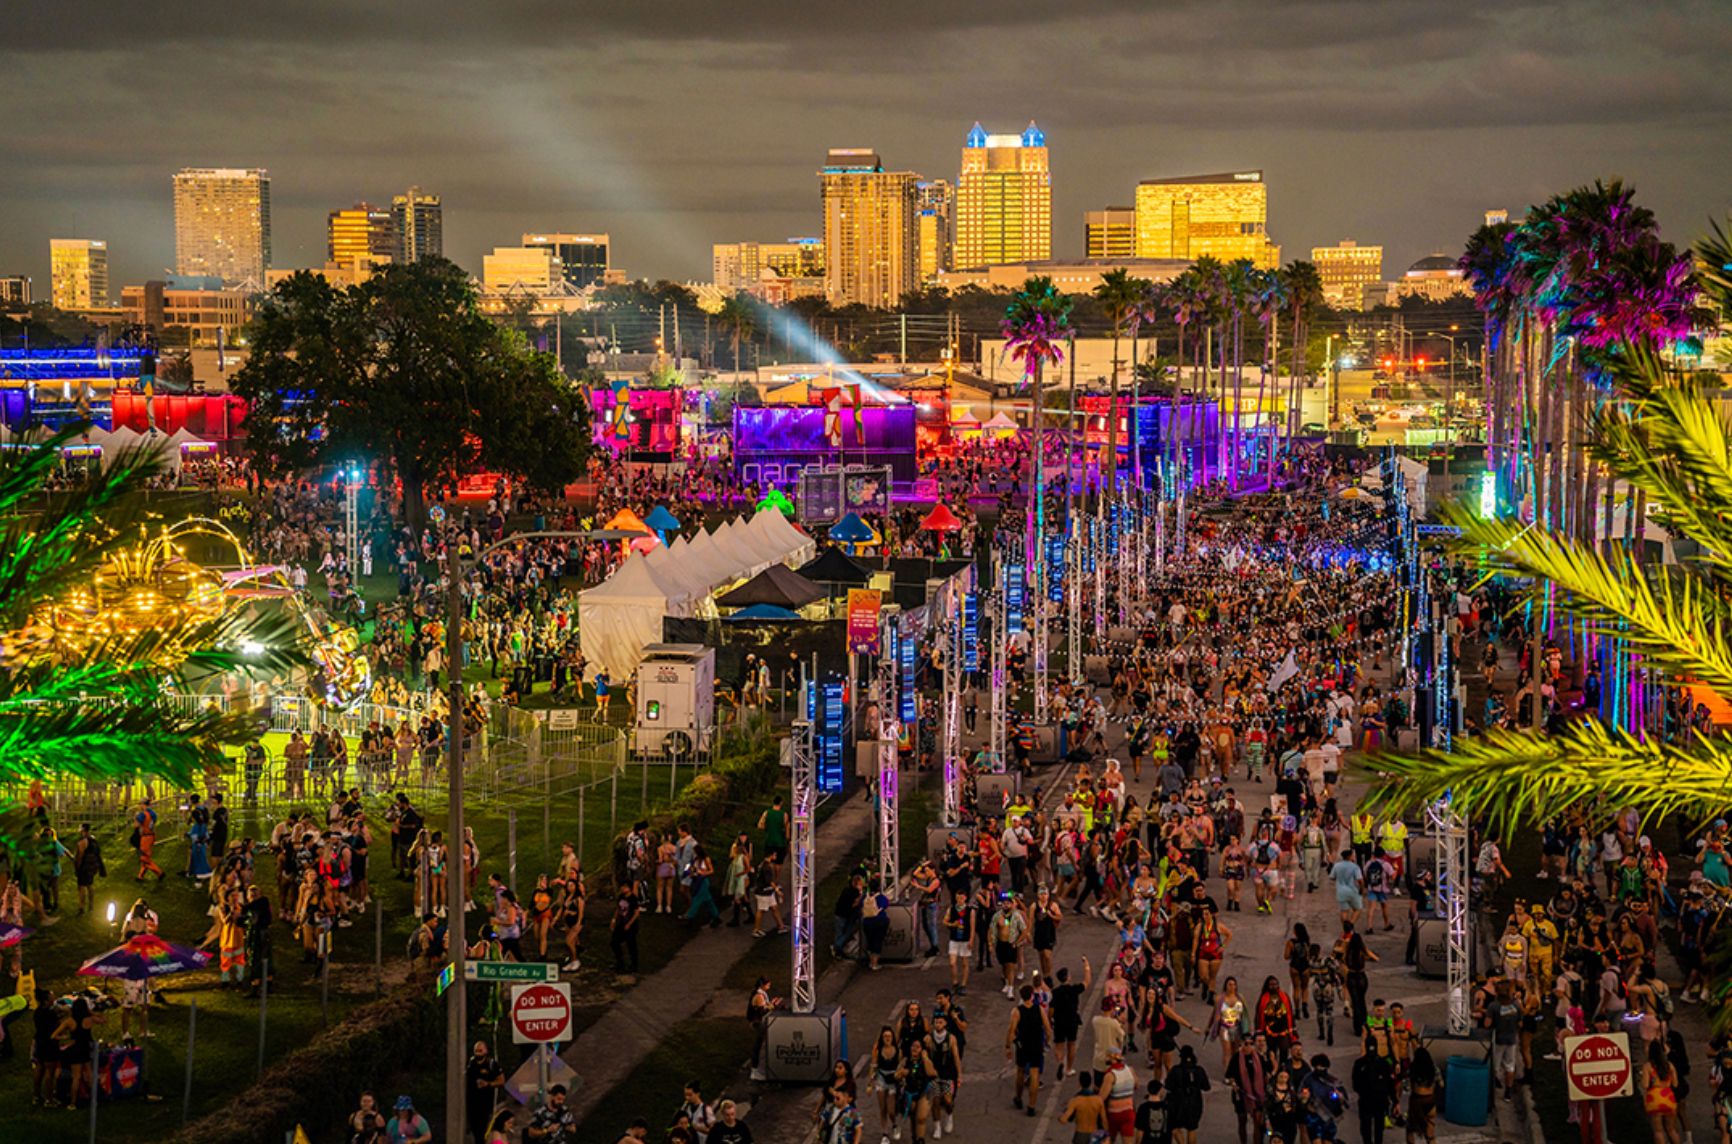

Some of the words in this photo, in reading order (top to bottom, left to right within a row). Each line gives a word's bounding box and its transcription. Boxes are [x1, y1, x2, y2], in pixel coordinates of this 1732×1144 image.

[483, 966, 497, 976] Rio
[499, 966, 528, 978] Grande
[521, 996, 536, 1007] DO
[541, 995, 561, 1005] NOT
[525, 1021, 558, 1031] ENTER
[1576, 1048, 1592, 1060] DO
[1597, 1046, 1619, 1058] NOT
[1582, 1074, 1617, 1087] ENTER
